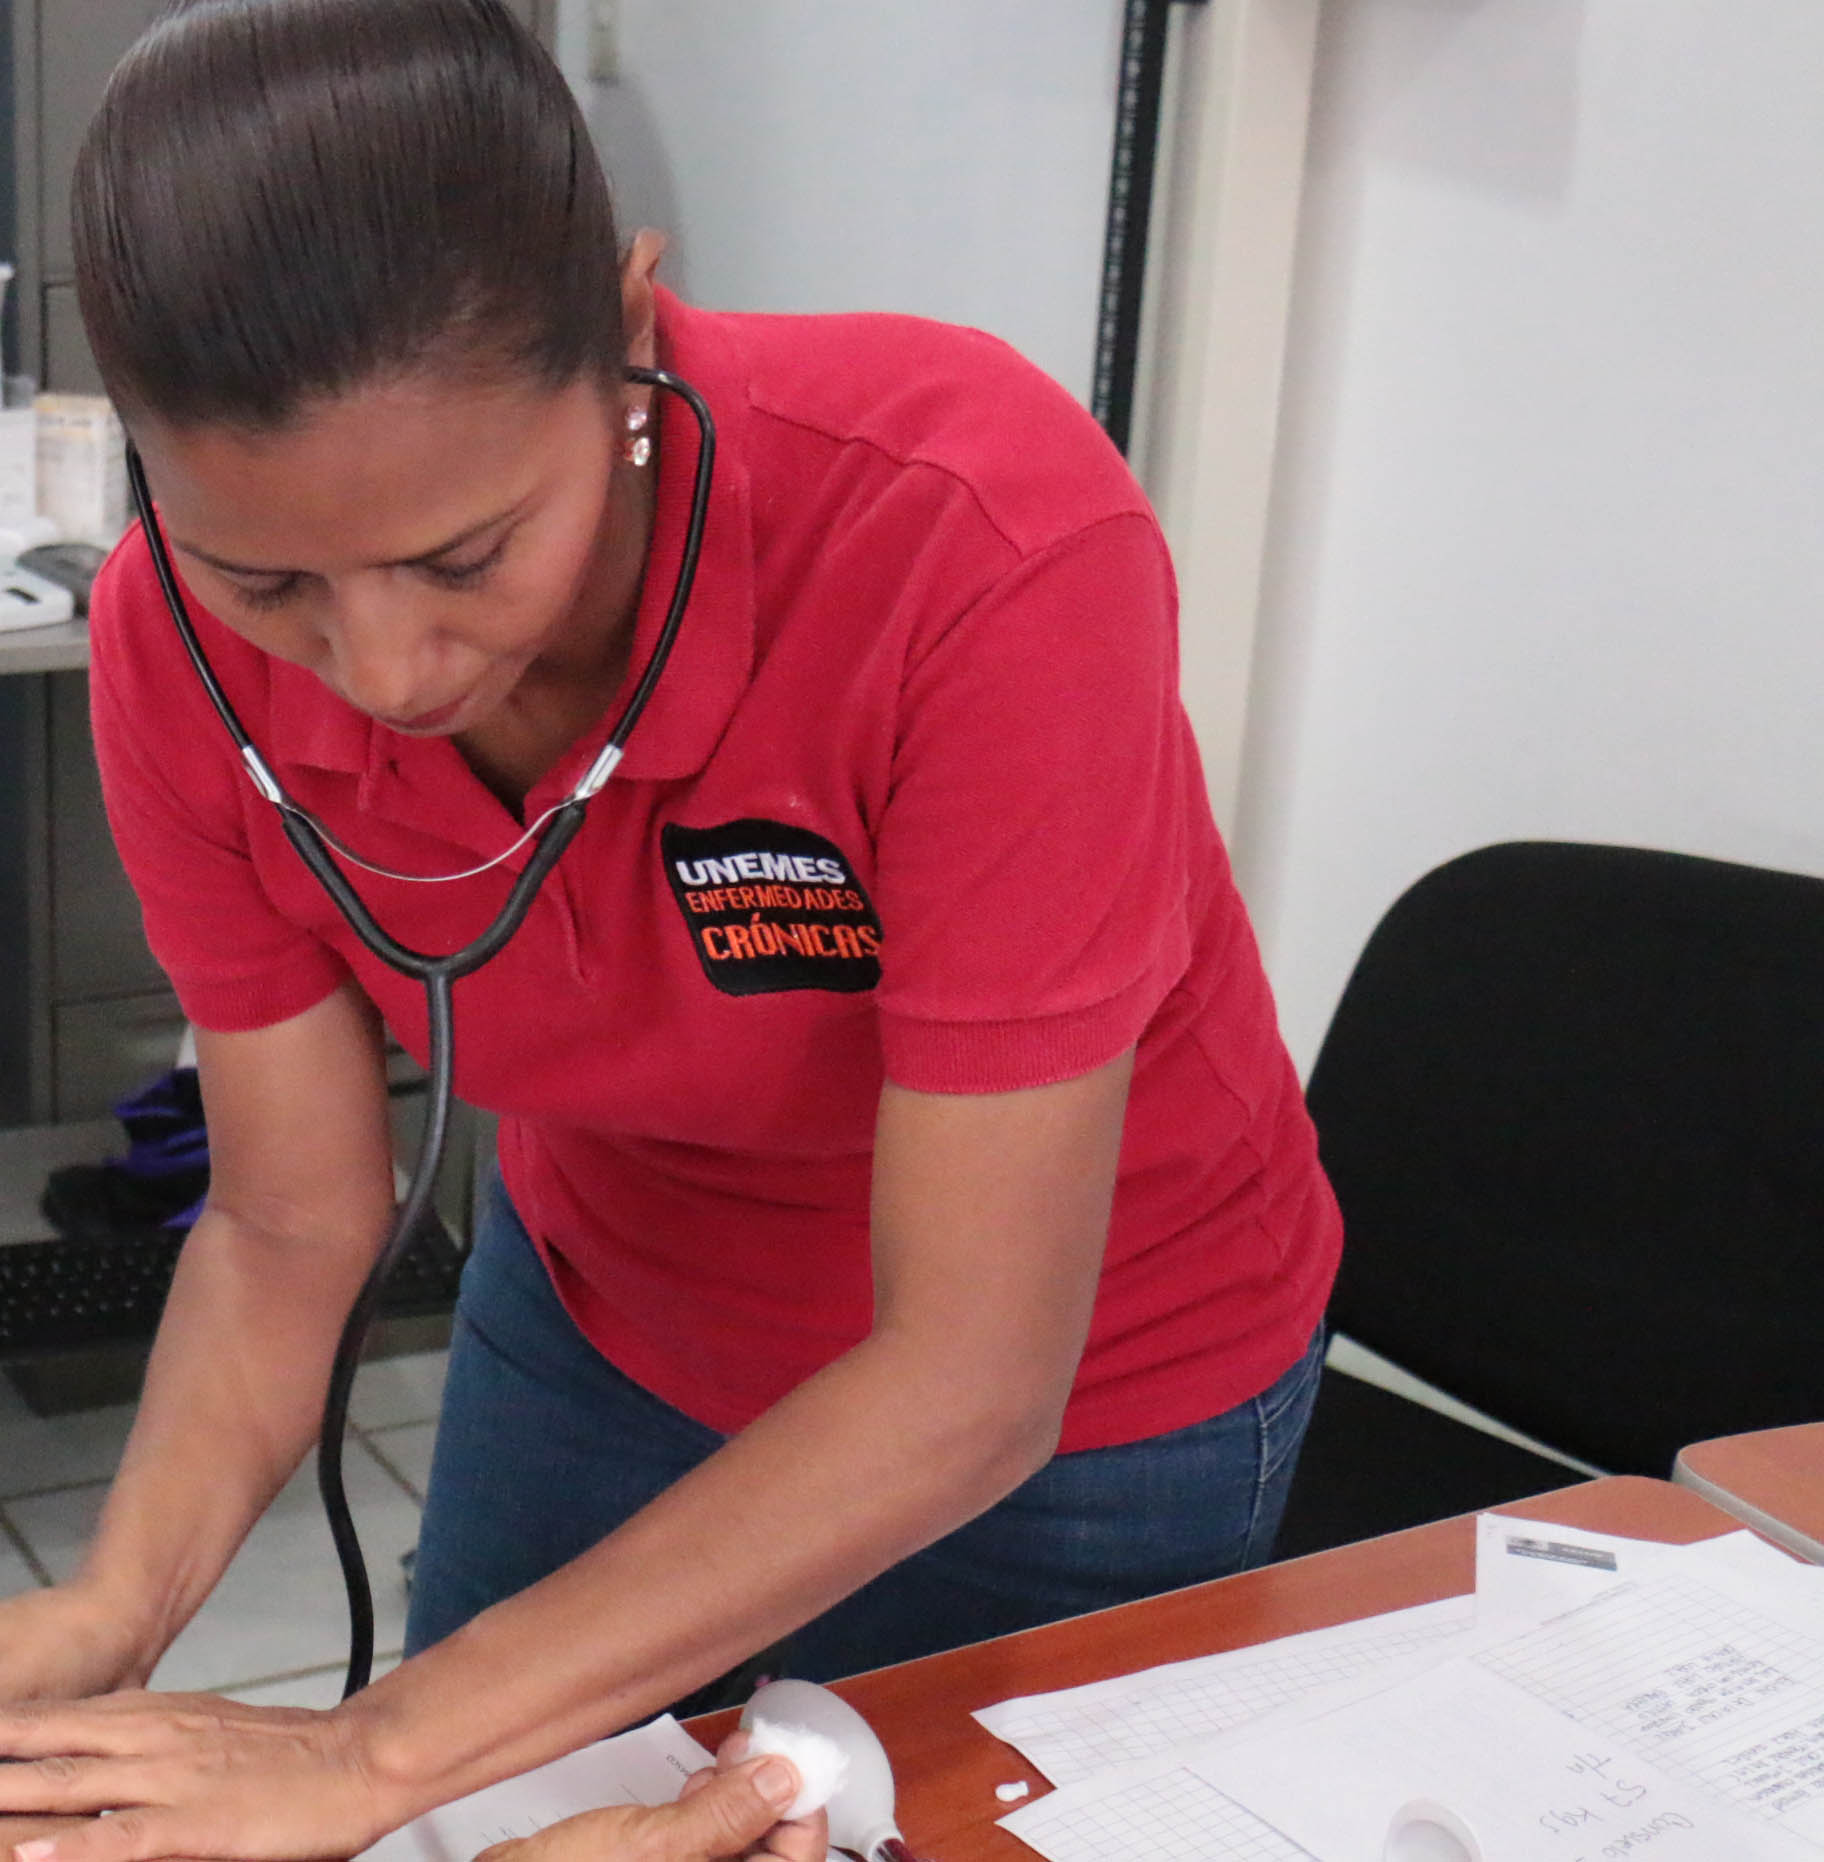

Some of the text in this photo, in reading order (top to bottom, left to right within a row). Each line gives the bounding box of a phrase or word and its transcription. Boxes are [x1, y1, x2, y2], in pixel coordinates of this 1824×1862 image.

[676, 852, 846, 885] UNEMES
[686, 885, 864, 913] ENFERMEDADES
[701, 912, 881, 960] CRÓNICAS
